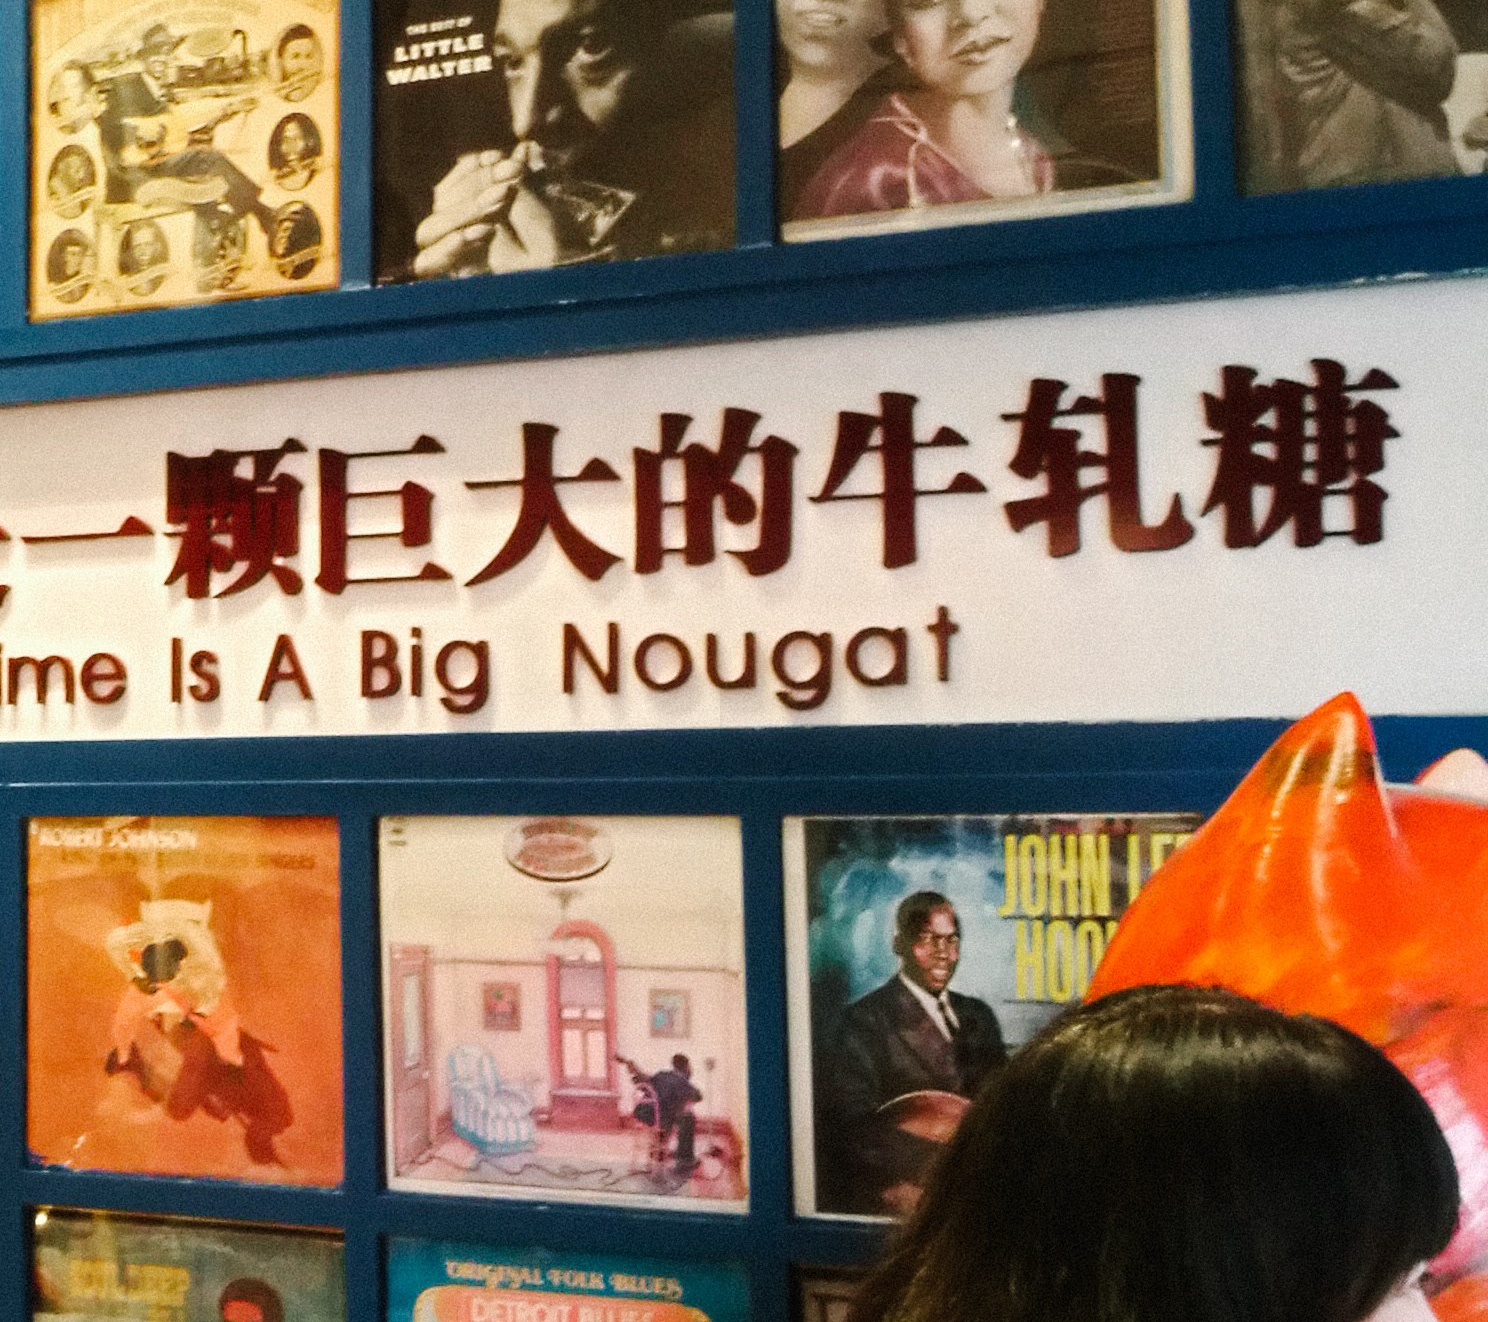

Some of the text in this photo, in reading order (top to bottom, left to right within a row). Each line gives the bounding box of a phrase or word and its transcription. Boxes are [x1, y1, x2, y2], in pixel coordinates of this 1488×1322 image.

[393, 33, 485, 63] LITTLE
[385, 55, 494, 86] WALTER
[171, 637, 222, 704] Is
[258, 634, 313, 703] A
[360, 627, 491, 714] Big
[562, 606, 961, 711] Nougat
[998, 834, 1112, 918] JOHN
[547, 1267, 606, 1290] FOLK
[609, 1272, 683, 1300] BLUES
